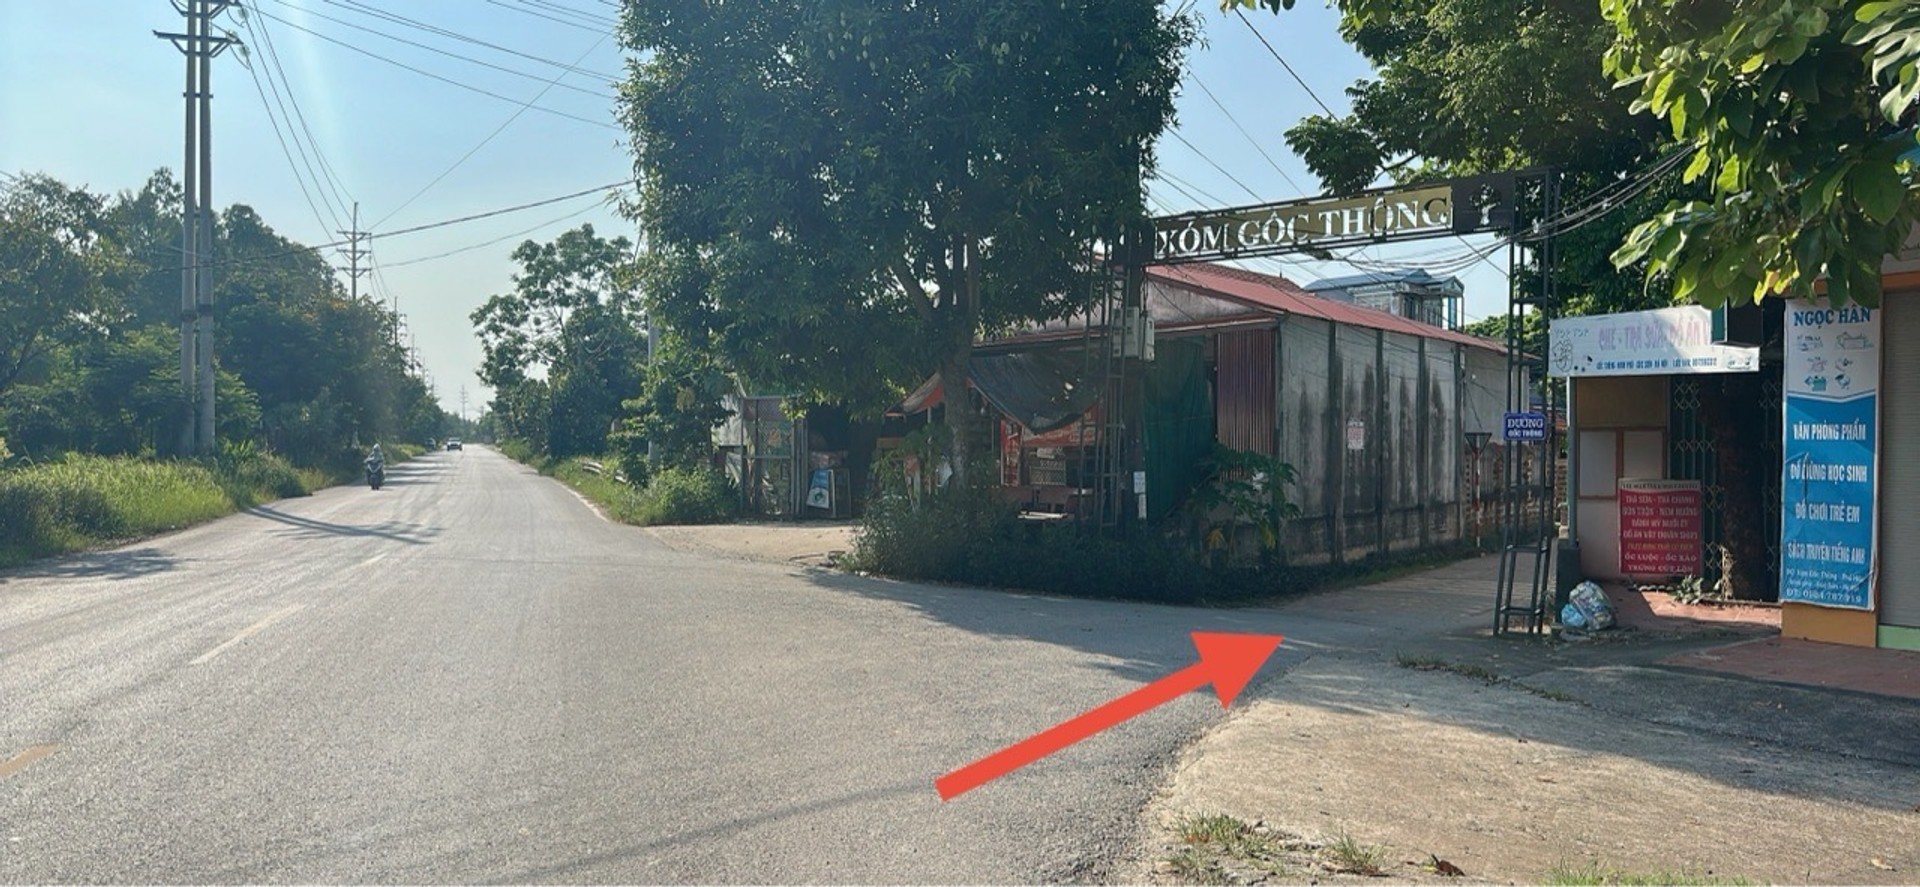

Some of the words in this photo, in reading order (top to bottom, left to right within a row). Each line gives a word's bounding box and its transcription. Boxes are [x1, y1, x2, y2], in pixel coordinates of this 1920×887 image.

[1318, 197, 1448, 238] THÔNG
[1794, 310, 1834, 329] NGỌC
[1838, 305, 1871, 323] HÂN
[1793, 421, 1810, 440] VĂN
[1811, 420, 1839, 441] PHÒNG
[1847, 465, 1867, 483] SINH
[1847, 505, 1860, 523] EM
